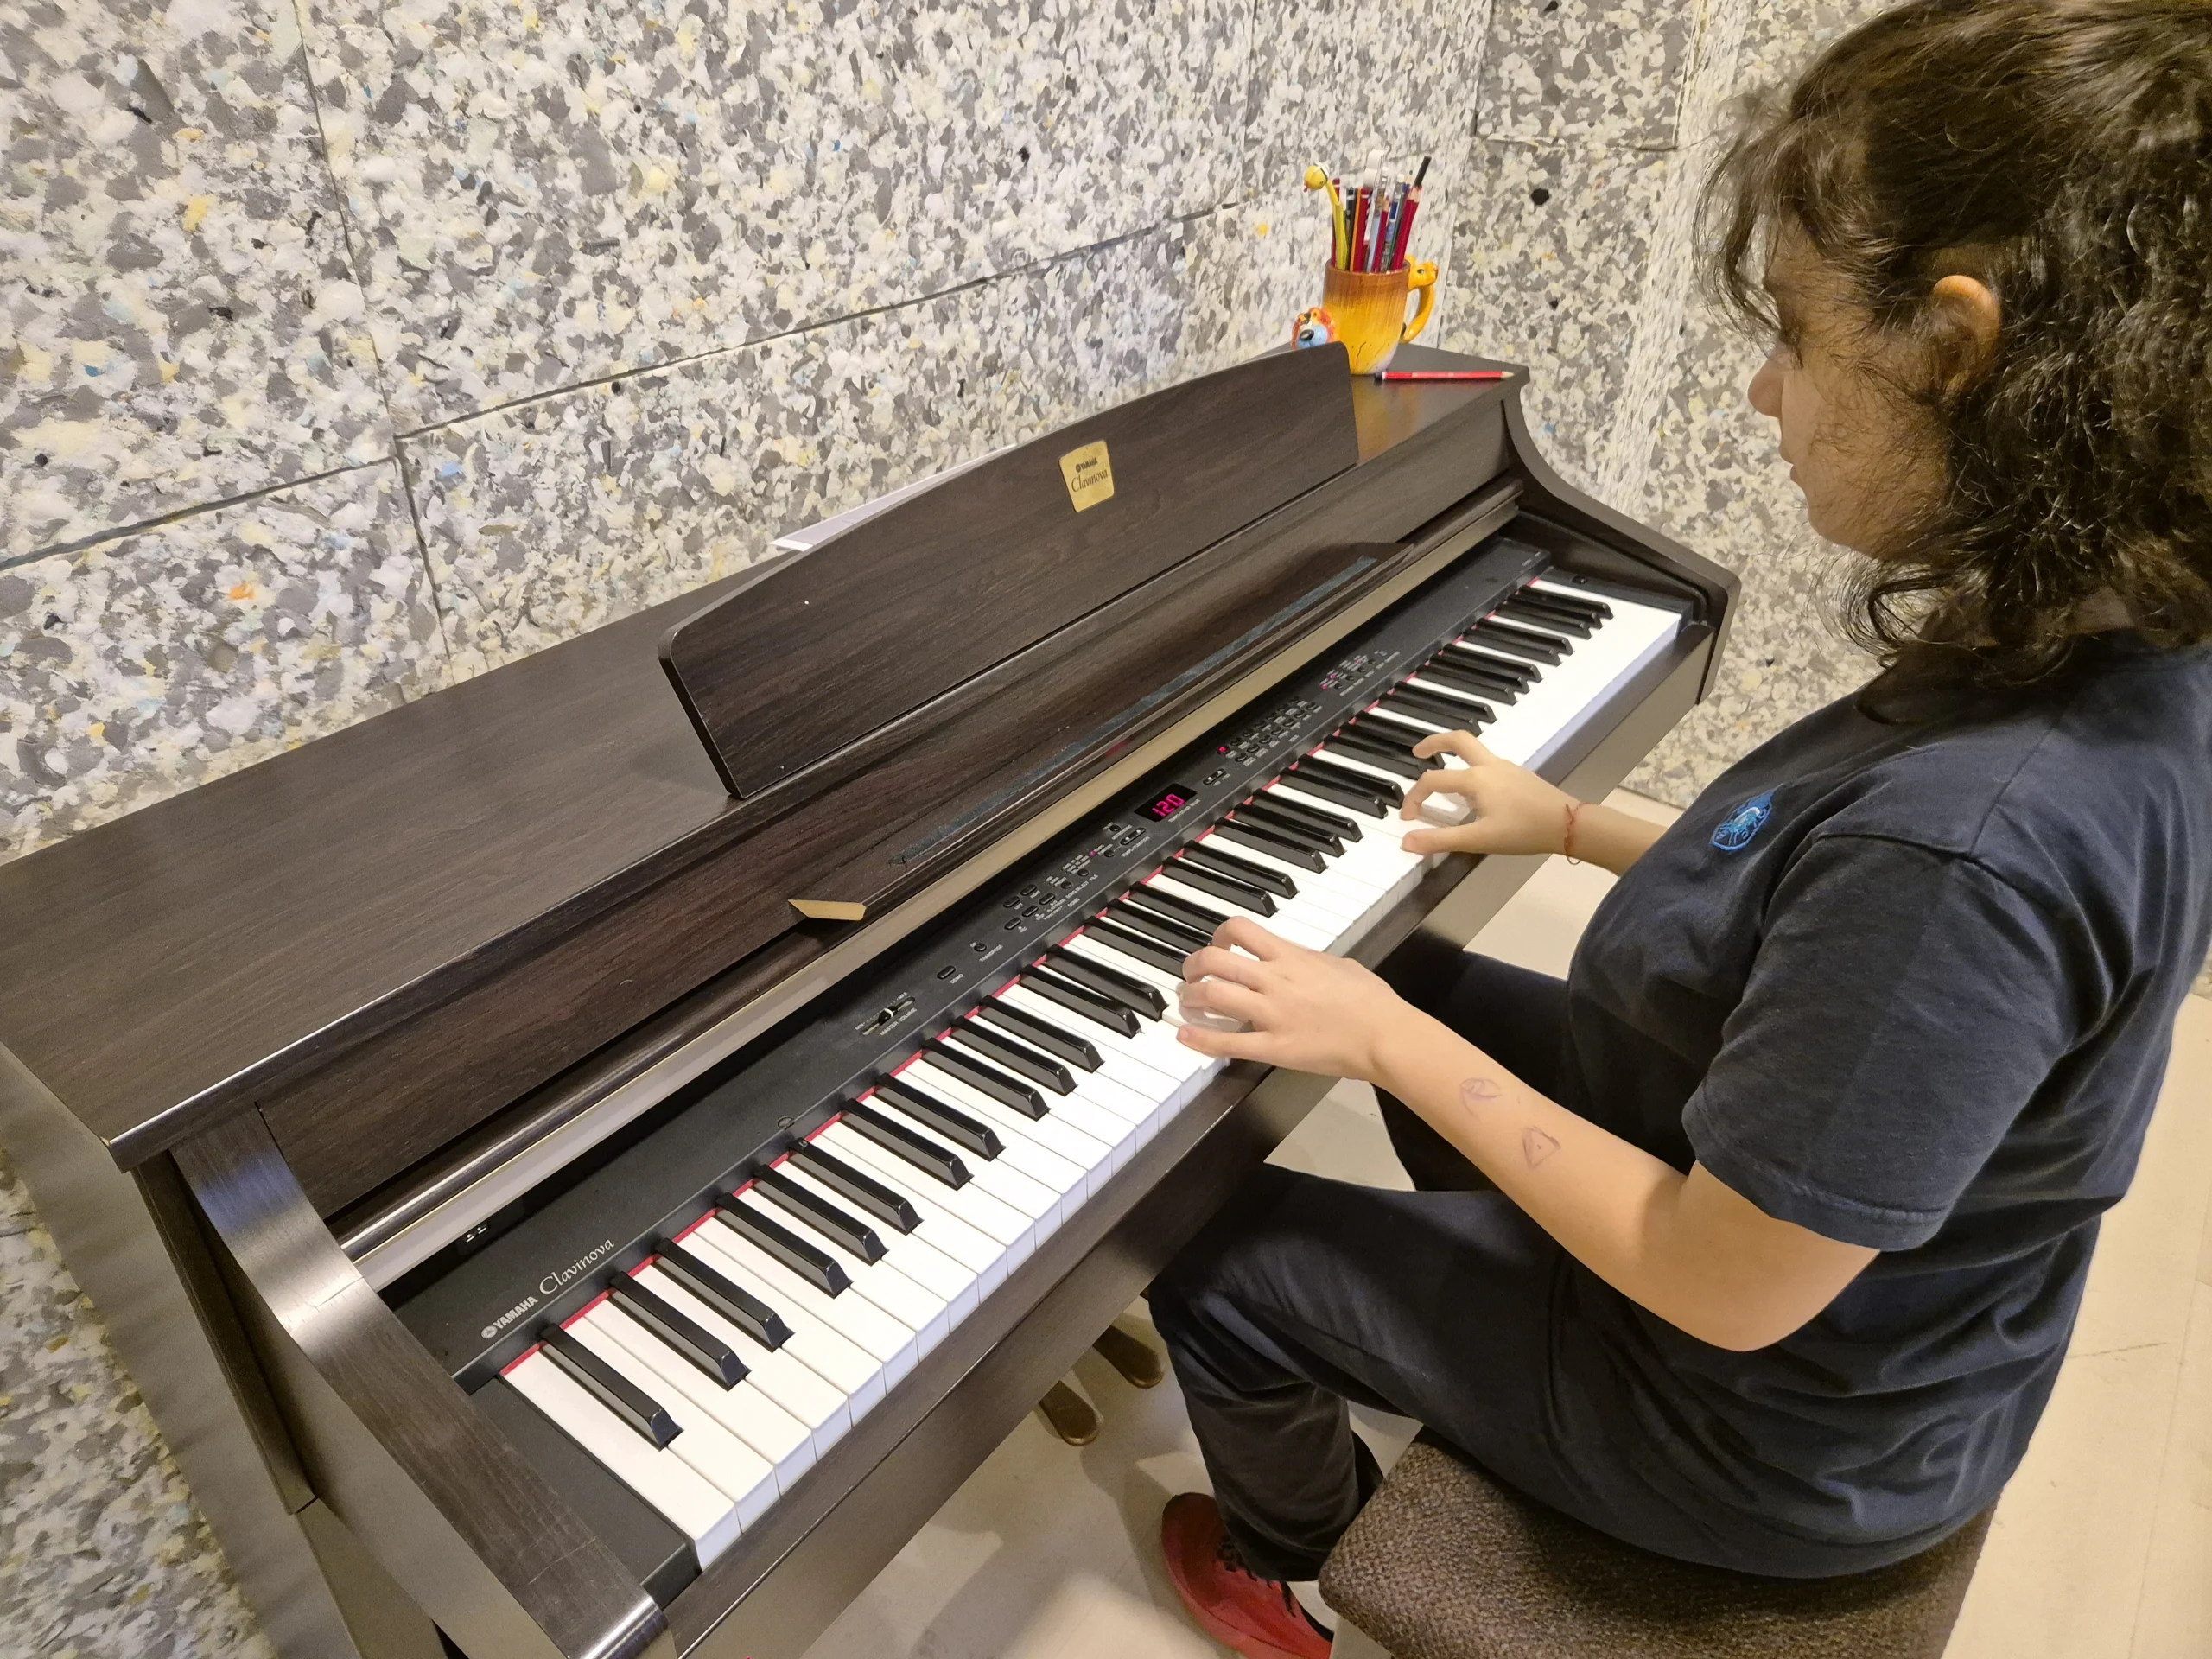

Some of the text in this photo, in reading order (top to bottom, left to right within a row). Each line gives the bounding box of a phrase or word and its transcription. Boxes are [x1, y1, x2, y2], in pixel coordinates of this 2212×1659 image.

[1080, 457, 1098, 470] YAMAHA
[1071, 469, 1108, 492] Clavinova
[1152, 793, 1185, 817] 120
[880, 1007, 918, 1035] MASTER VOLUME
[539, 1239, 614, 1294] Clavinova
[493, 1296, 538, 1329] YAMAHA
